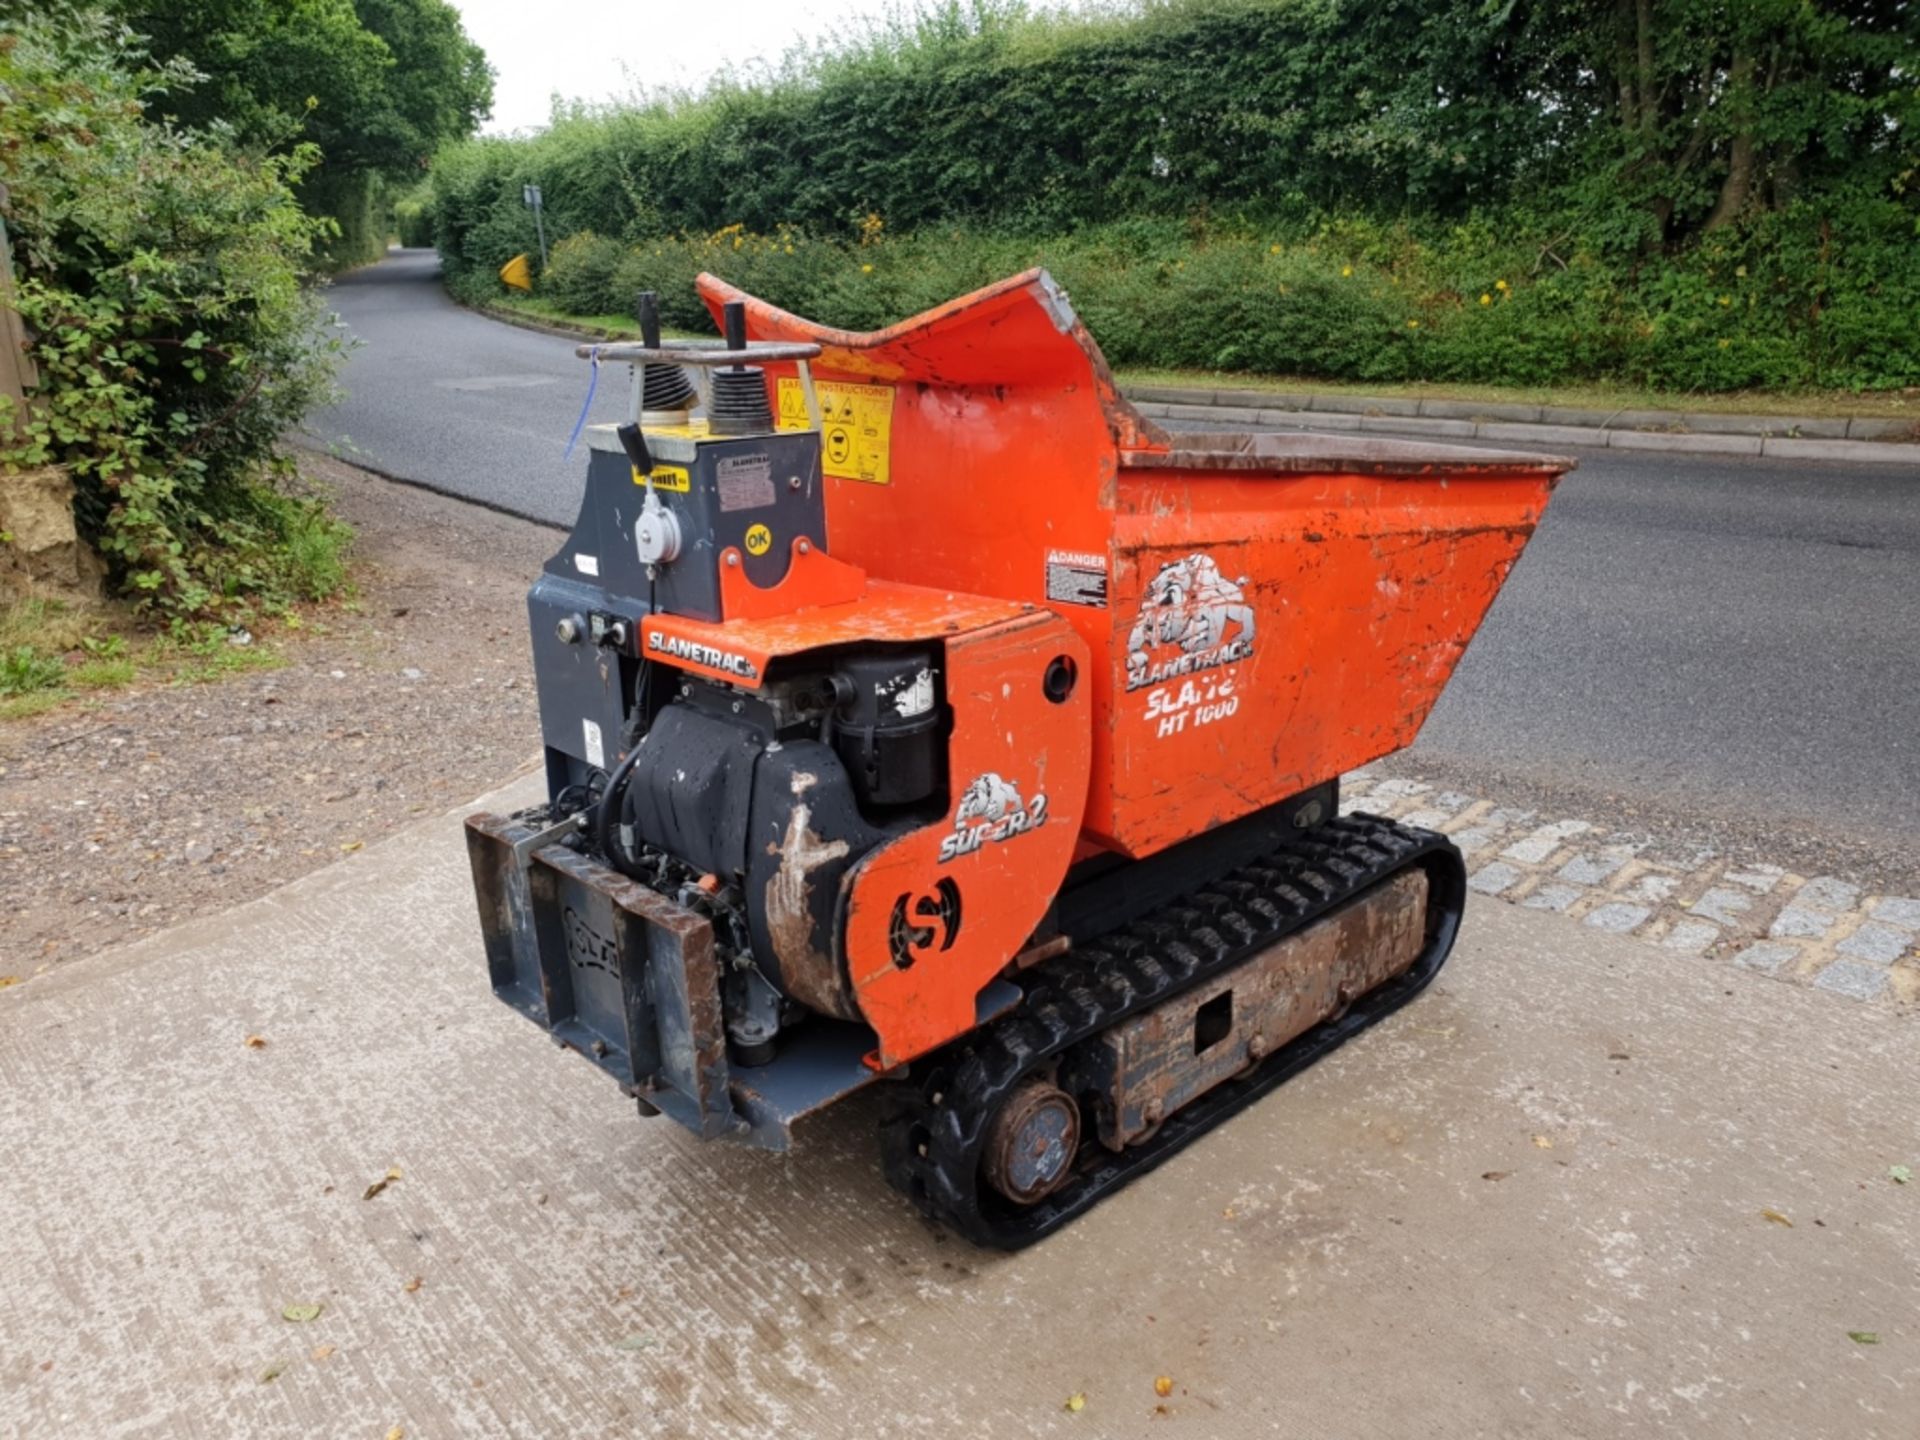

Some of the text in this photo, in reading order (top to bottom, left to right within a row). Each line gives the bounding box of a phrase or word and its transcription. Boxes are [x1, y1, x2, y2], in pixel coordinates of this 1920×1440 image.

[817, 383, 888, 398] INSTRUCTIONS
[748, 531, 768, 549] OK
[1059, 551, 1106, 569] DANGER
[1157, 710, 1189, 738] HT
